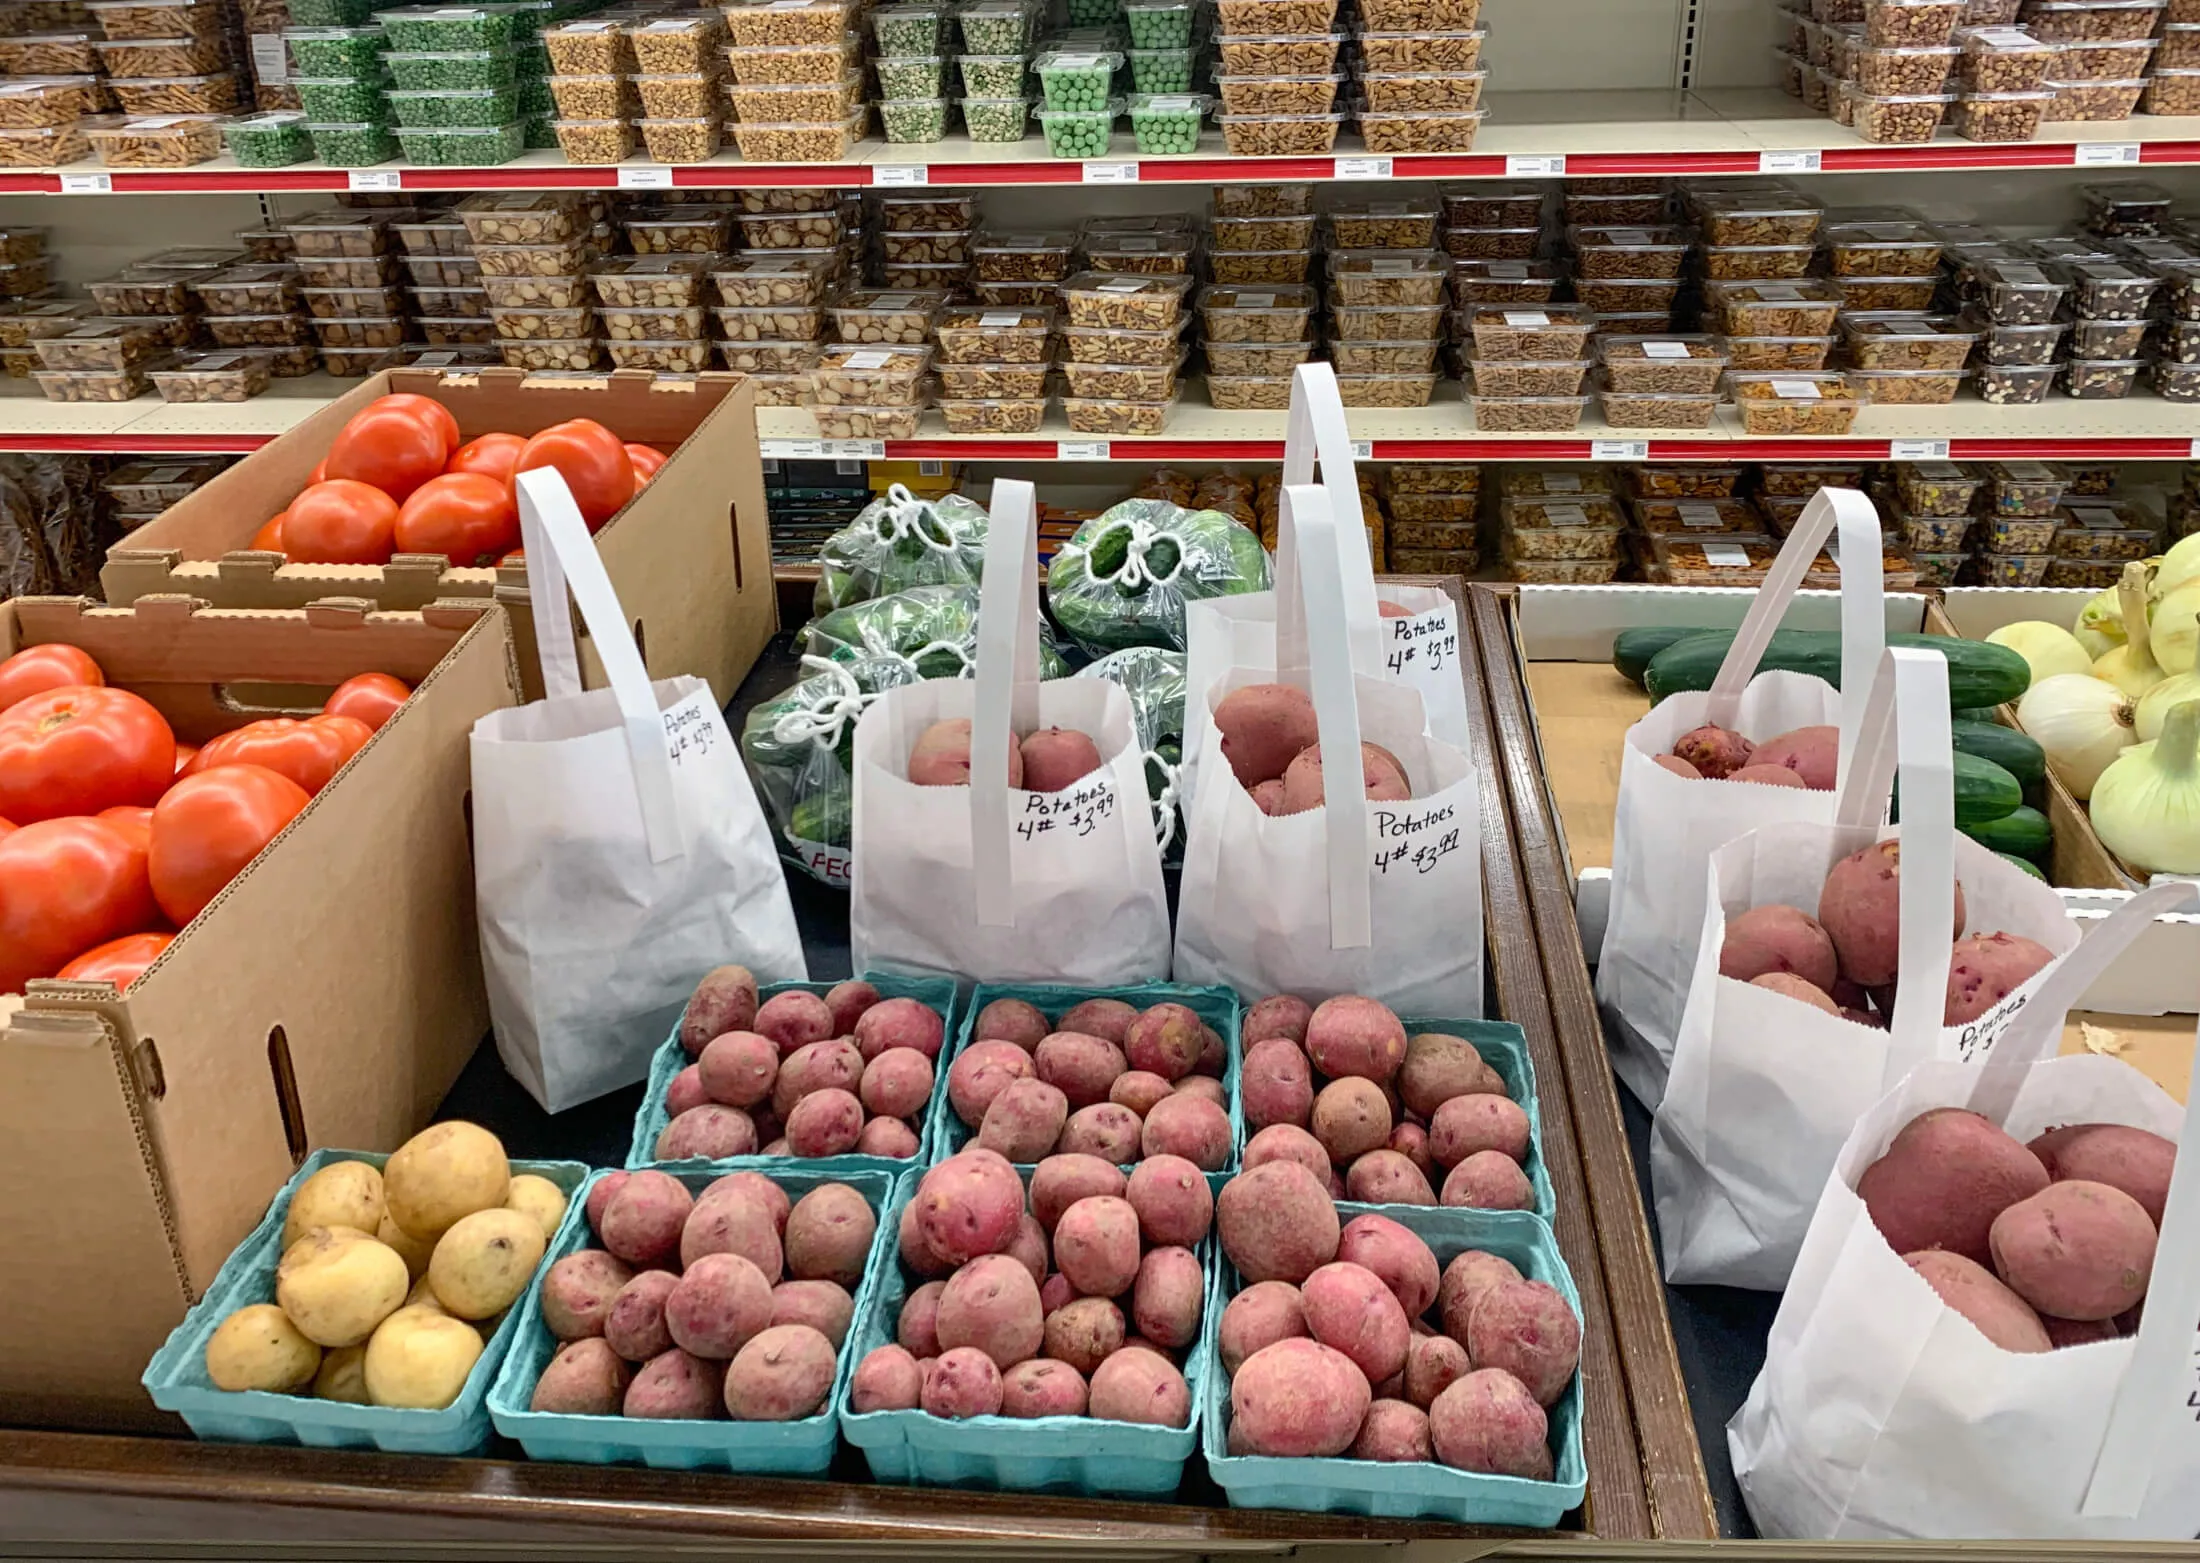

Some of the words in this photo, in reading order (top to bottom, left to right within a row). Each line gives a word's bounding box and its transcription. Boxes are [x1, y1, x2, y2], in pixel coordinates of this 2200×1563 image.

[1394, 616, 1446, 640] Potatoes
[1025, 782, 1107, 815] Potatoes
[1373, 804, 1454, 838] Potatoes
